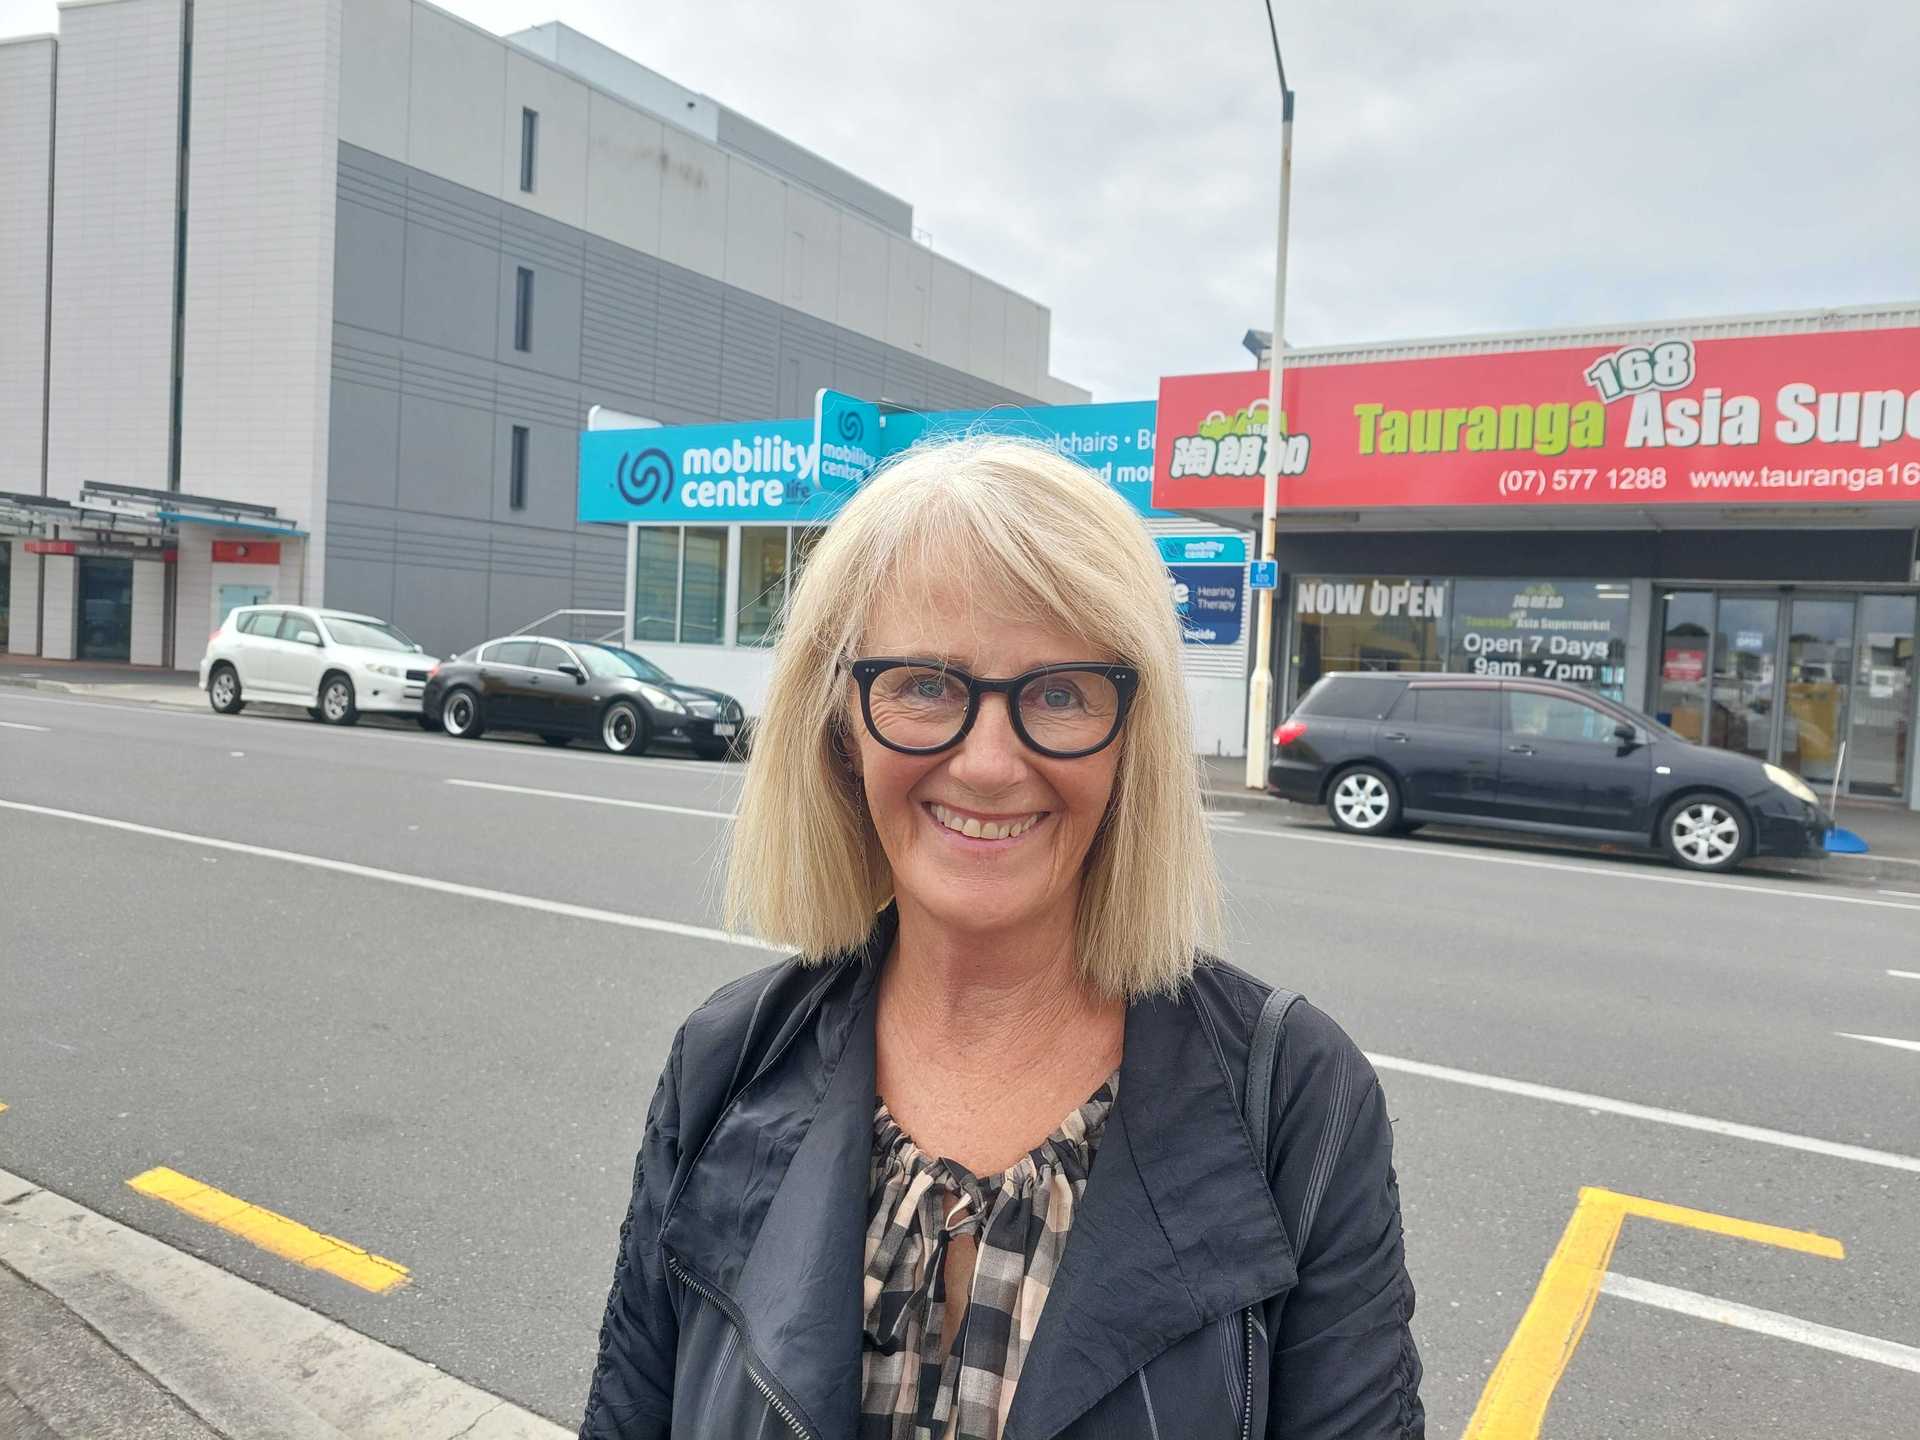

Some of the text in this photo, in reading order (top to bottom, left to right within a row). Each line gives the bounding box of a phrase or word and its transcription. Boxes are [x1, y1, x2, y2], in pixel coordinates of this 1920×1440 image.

[1586, 340, 1692, 401] 168
[1354, 403, 1606, 456] Tauranga
[1624, 388, 1760, 448] Asia
[823, 443, 877, 468] mobility
[1048, 431, 1118, 452] lchairs
[683, 435, 817, 480] mobility
[1499, 467, 1667, 496] (07) 577 1288
[1689, 462, 1920, 491] www.tauranga16
[681, 476, 784, 508] centre
[1258, 563, 1268, 574] P
[1197, 586, 1235, 599] Hearing
[1197, 598, 1236, 611] Therapy
[1297, 583, 1445, 618] NOW OPEN
[1463, 633, 1609, 660] Open 7 Days
[1474, 657, 1521, 677] 9am
[1543, 660, 1594, 681] 7pm
